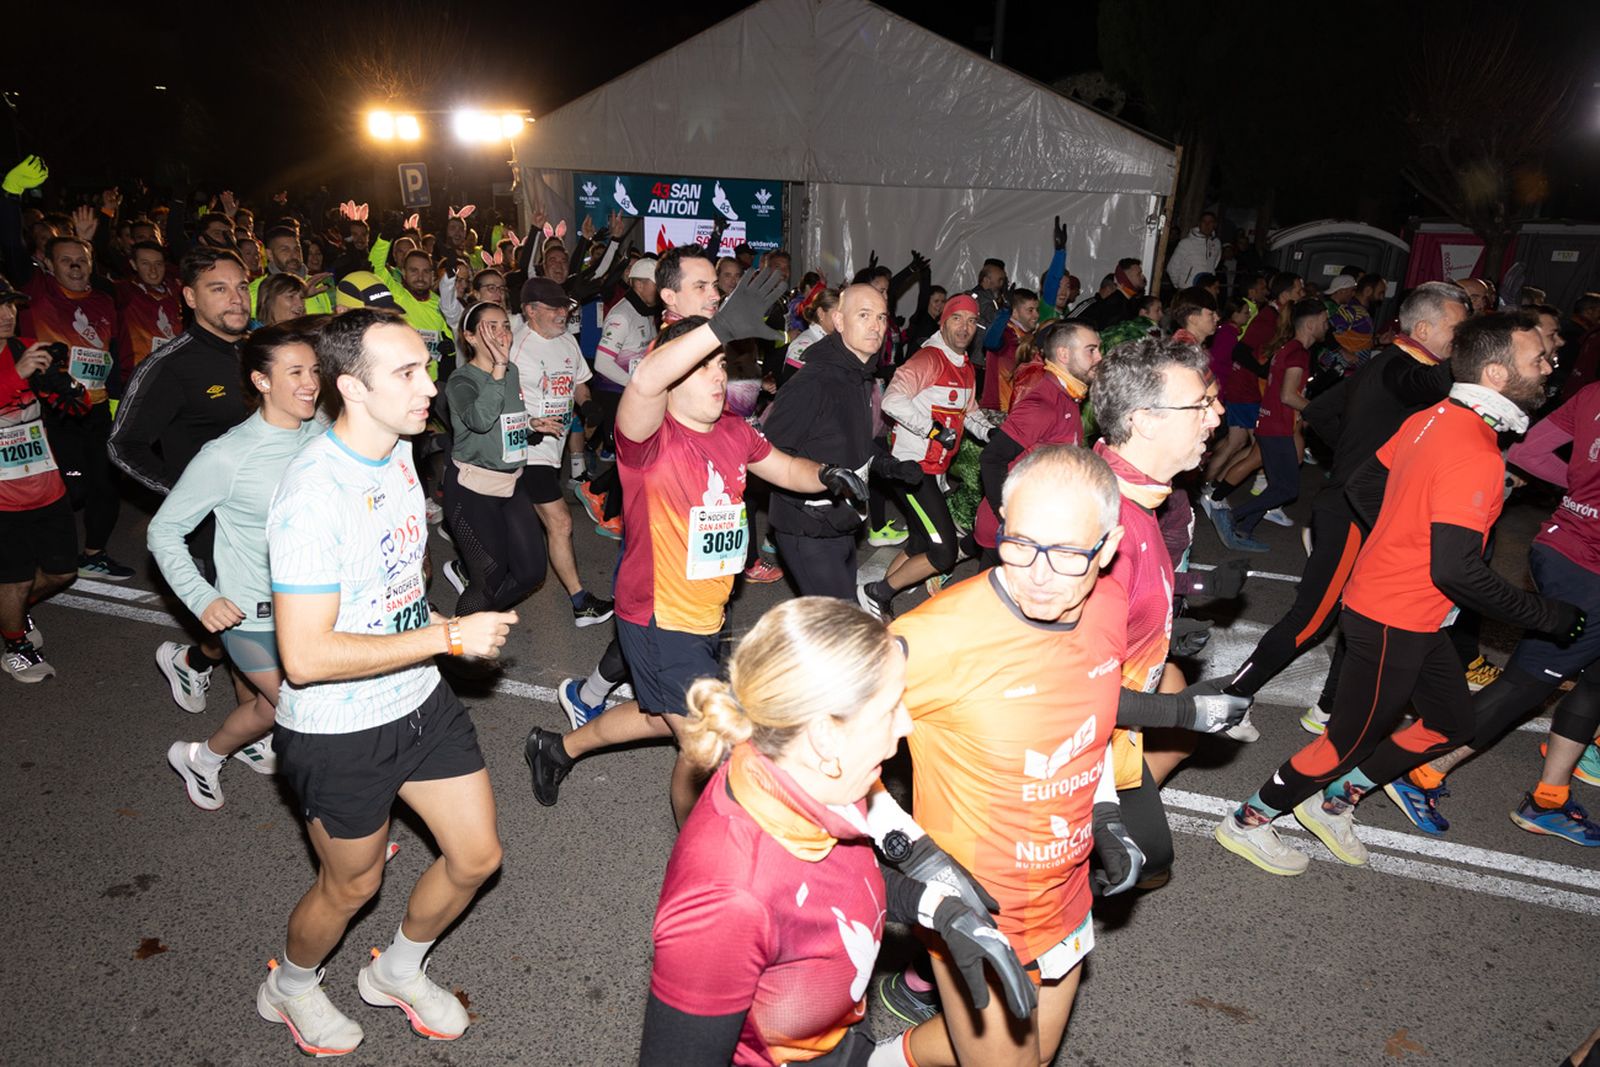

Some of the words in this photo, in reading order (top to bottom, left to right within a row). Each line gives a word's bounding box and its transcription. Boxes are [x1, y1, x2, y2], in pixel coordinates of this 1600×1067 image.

[405, 168, 423, 193] P
[651, 182, 670, 199] 43
[670, 183, 701, 199] SAN
[621, 198, 630, 209] 43
[647, 196, 699, 215] ANTÓN
[720, 203, 730, 213] 43
[696, 236, 711, 247] SA
[82, 328, 96, 340] 43
[82, 363, 106, 377] 7470
[1, 441, 43, 462] 12076
[708, 513, 727, 521] NOCHE
[728, 512, 735, 520] DE
[698, 523, 713, 531] SAN
[703, 529, 743, 554] 3030
[393, 579, 412, 596] NOCHE
[386, 598, 403, 612] SAN
